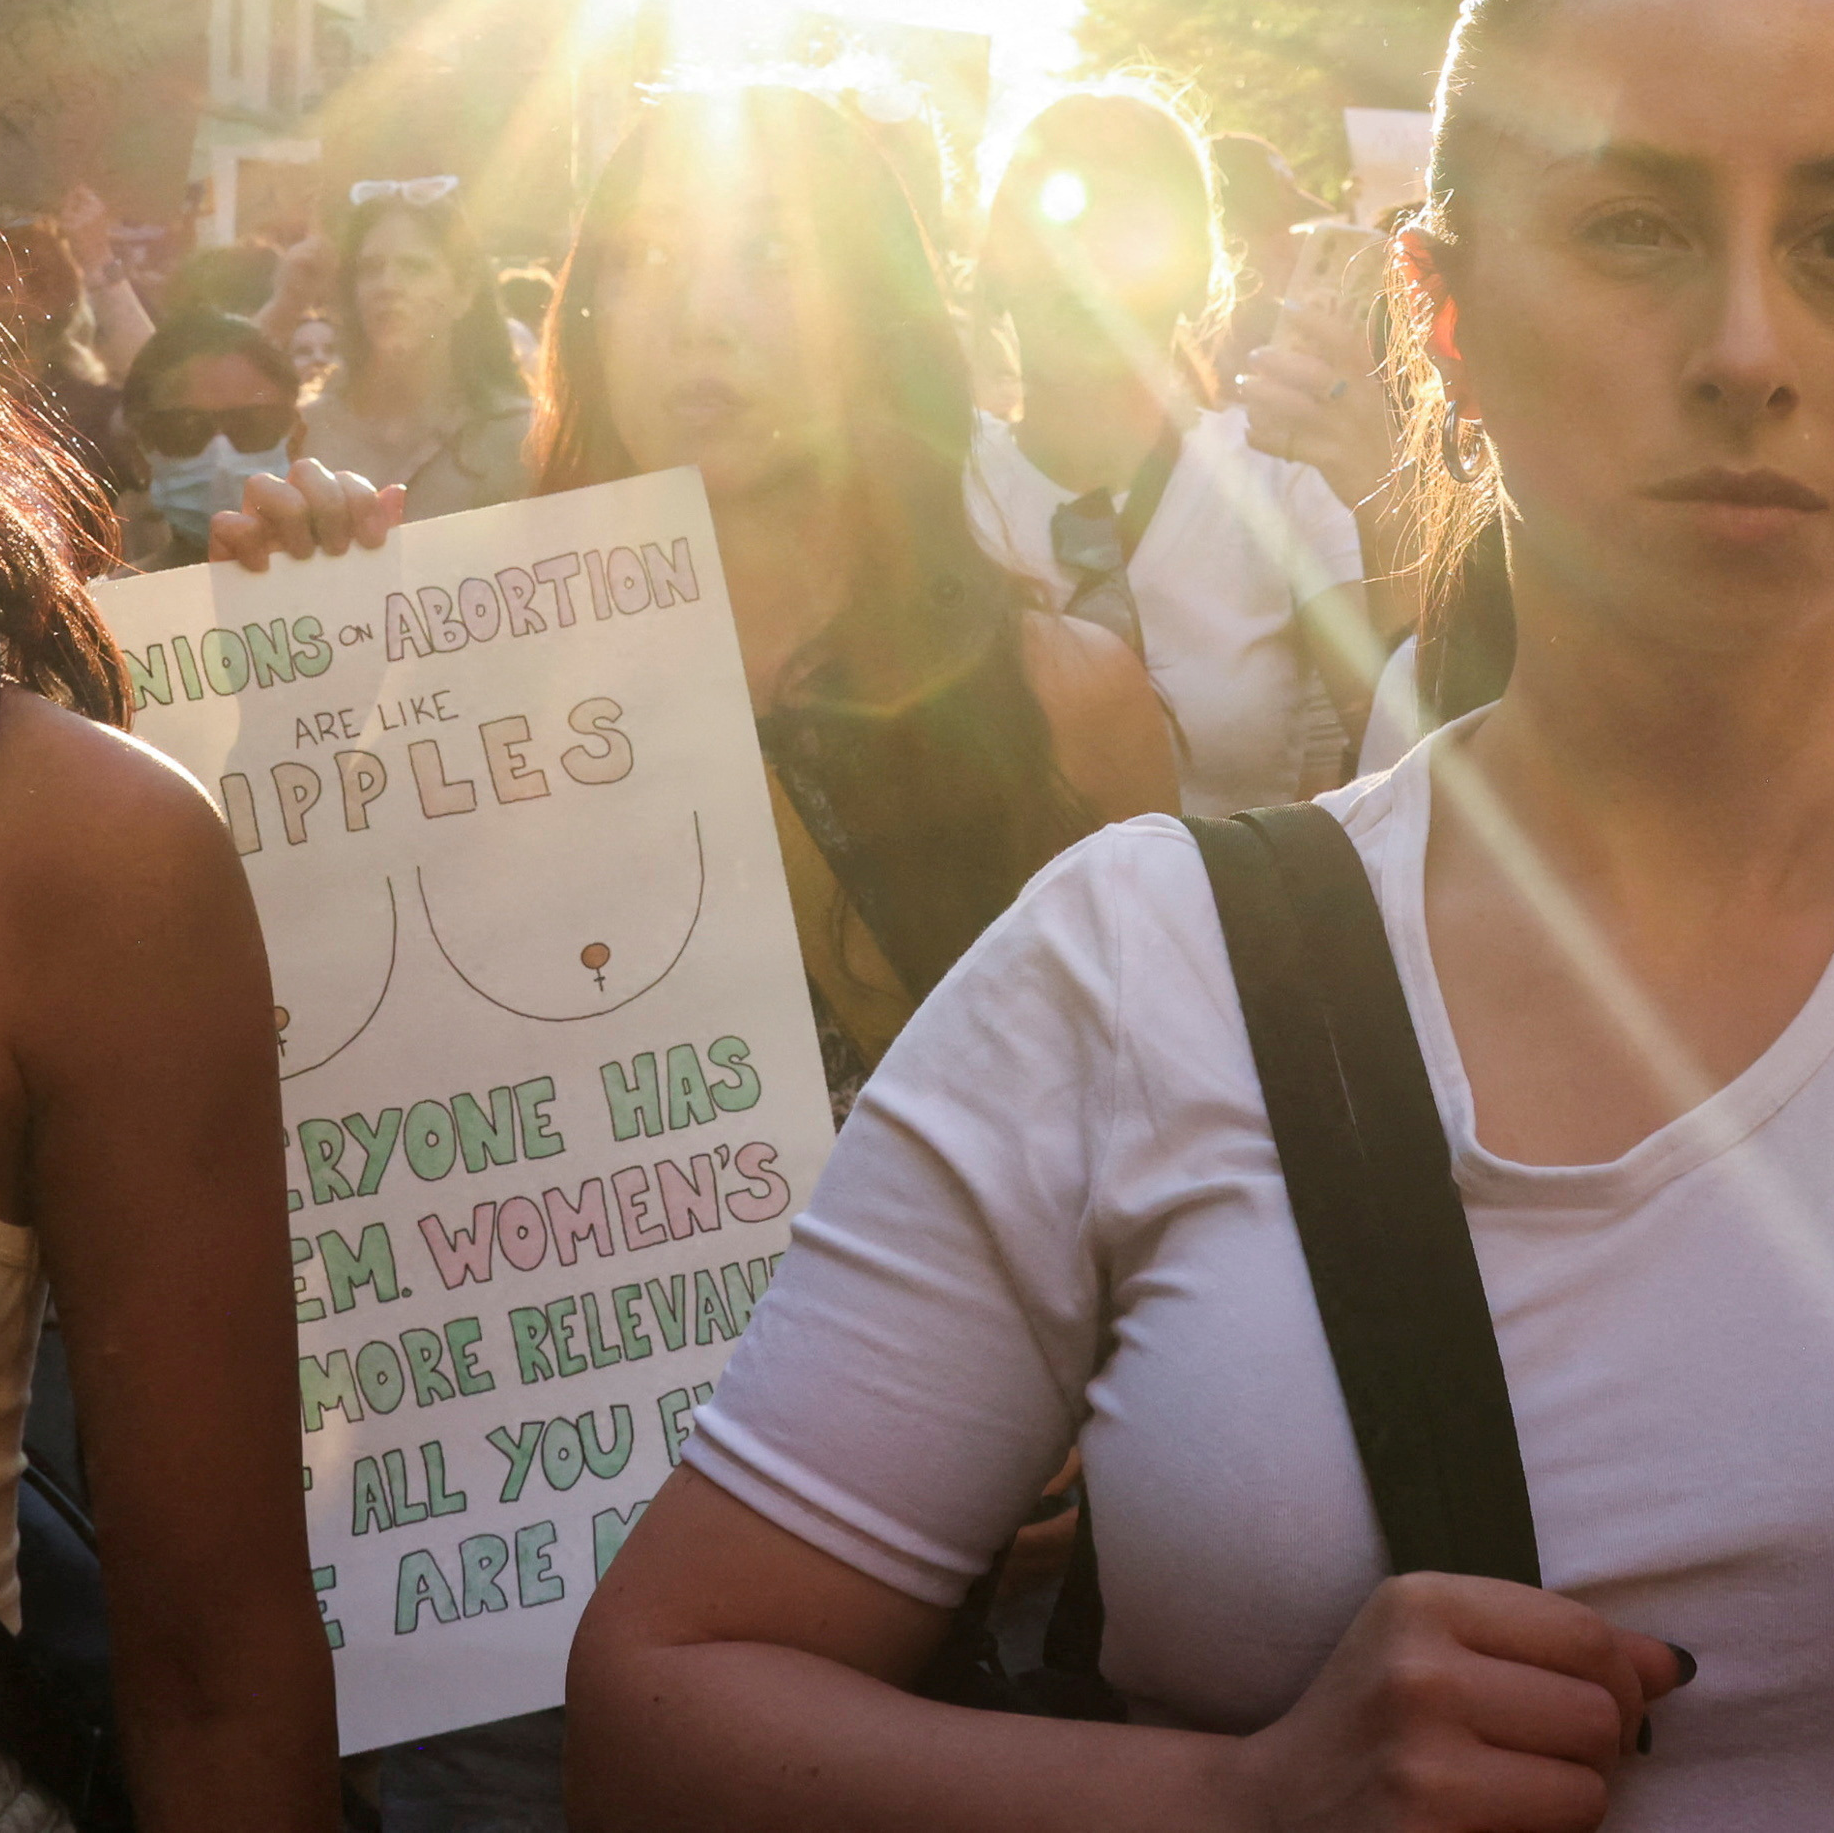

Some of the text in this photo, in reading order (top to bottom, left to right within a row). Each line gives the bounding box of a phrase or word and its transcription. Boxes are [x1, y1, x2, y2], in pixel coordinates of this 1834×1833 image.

[385, 538, 700, 662] ABORTION
[220, 697, 634, 858] IPPLES
[294, 690, 459, 749] ARE LIKE
[282, 1036, 761, 1213] RYONE HAS
[418, 1141, 790, 1290] WOMEN'S
[298, 1252, 787, 1434] MORE RELEVAN
[352, 1441, 466, 1536] ALL
[486, 1405, 633, 1504] YOU
[394, 1520, 564, 1635] ARE
